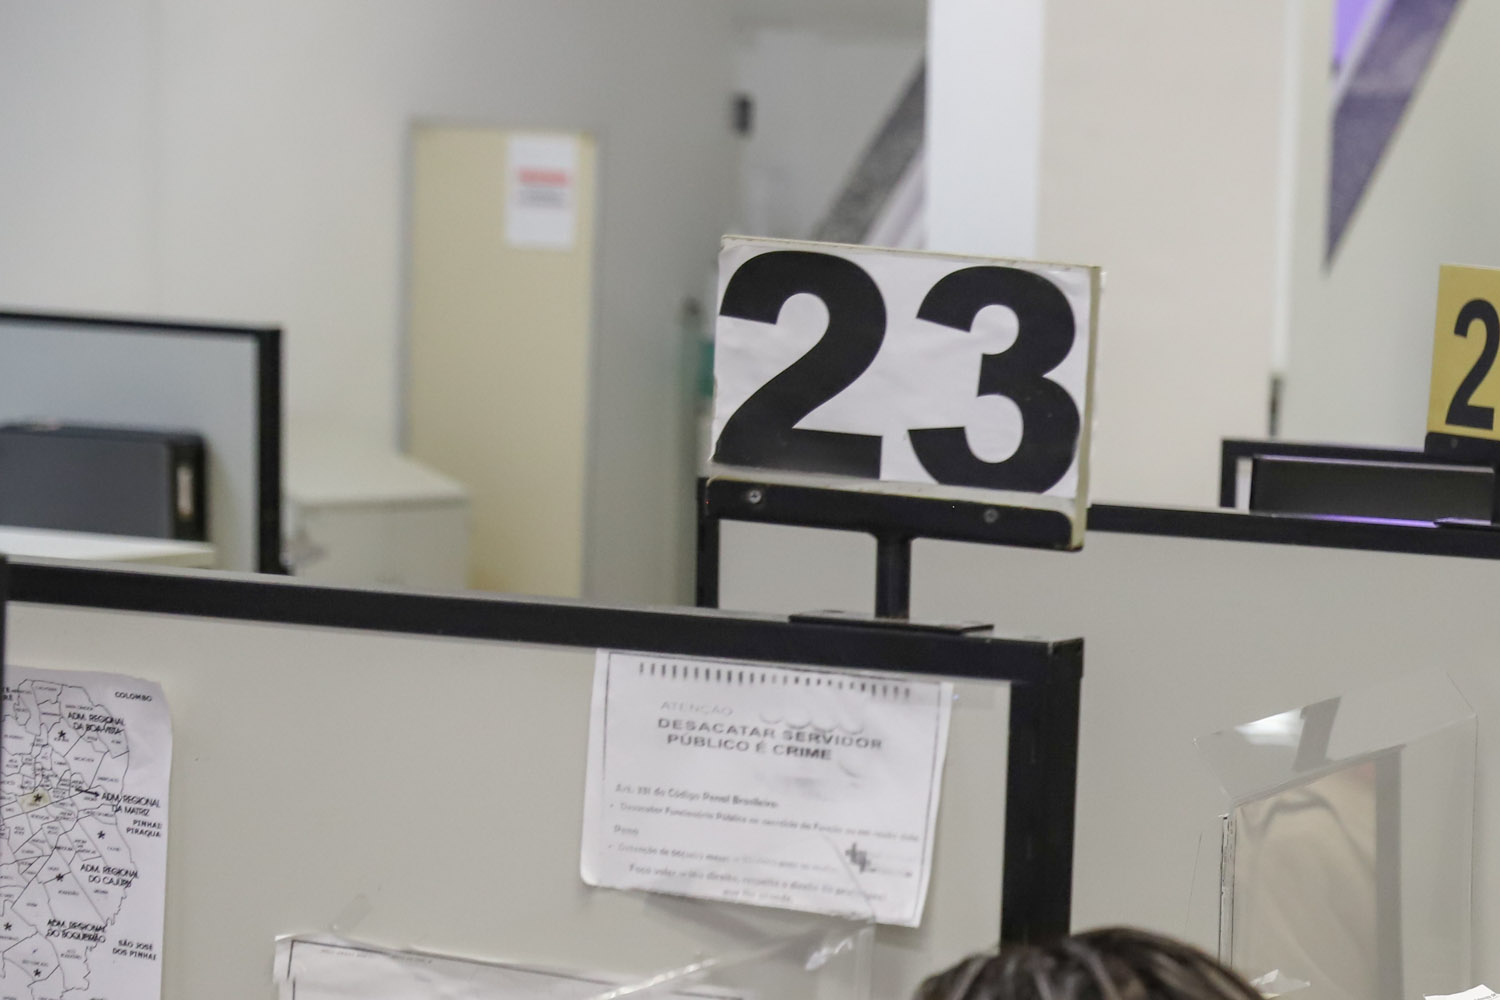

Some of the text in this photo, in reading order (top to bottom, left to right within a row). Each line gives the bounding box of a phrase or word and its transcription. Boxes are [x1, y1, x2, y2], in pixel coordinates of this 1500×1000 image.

[712, 250, 1080, 494] 23
[114, 691, 153, 702] COLOMBO
[657, 717, 884, 751] DESACATAR SERVIDOR
[666, 732, 750, 753] PÚBLICO
[772, 743, 833, 762] CRIME
